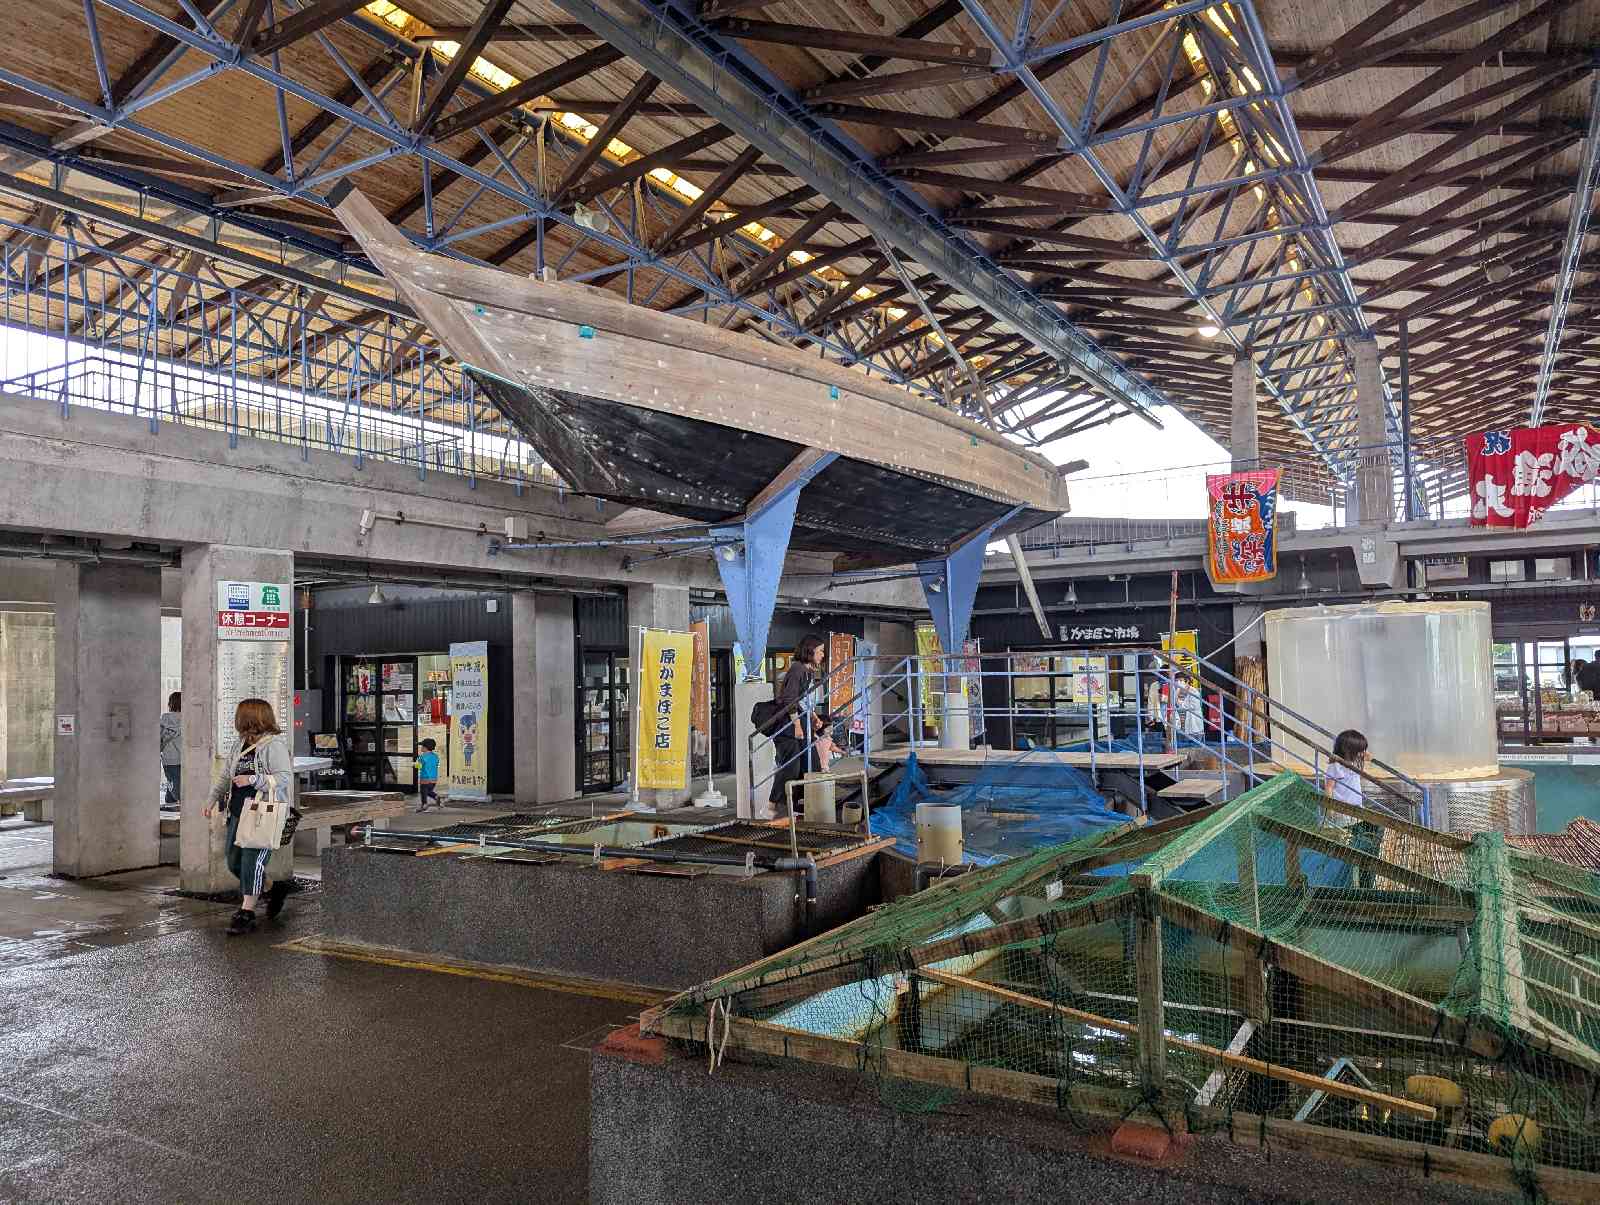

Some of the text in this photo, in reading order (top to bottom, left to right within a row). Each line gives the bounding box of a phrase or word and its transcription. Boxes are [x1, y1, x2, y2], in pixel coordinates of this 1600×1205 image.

[221, 612, 287, 626] 休憩コーナー
[1070, 625, 1140, 640] かまぼこ市場
[655, 648, 676, 749] 原かまぼこ店
